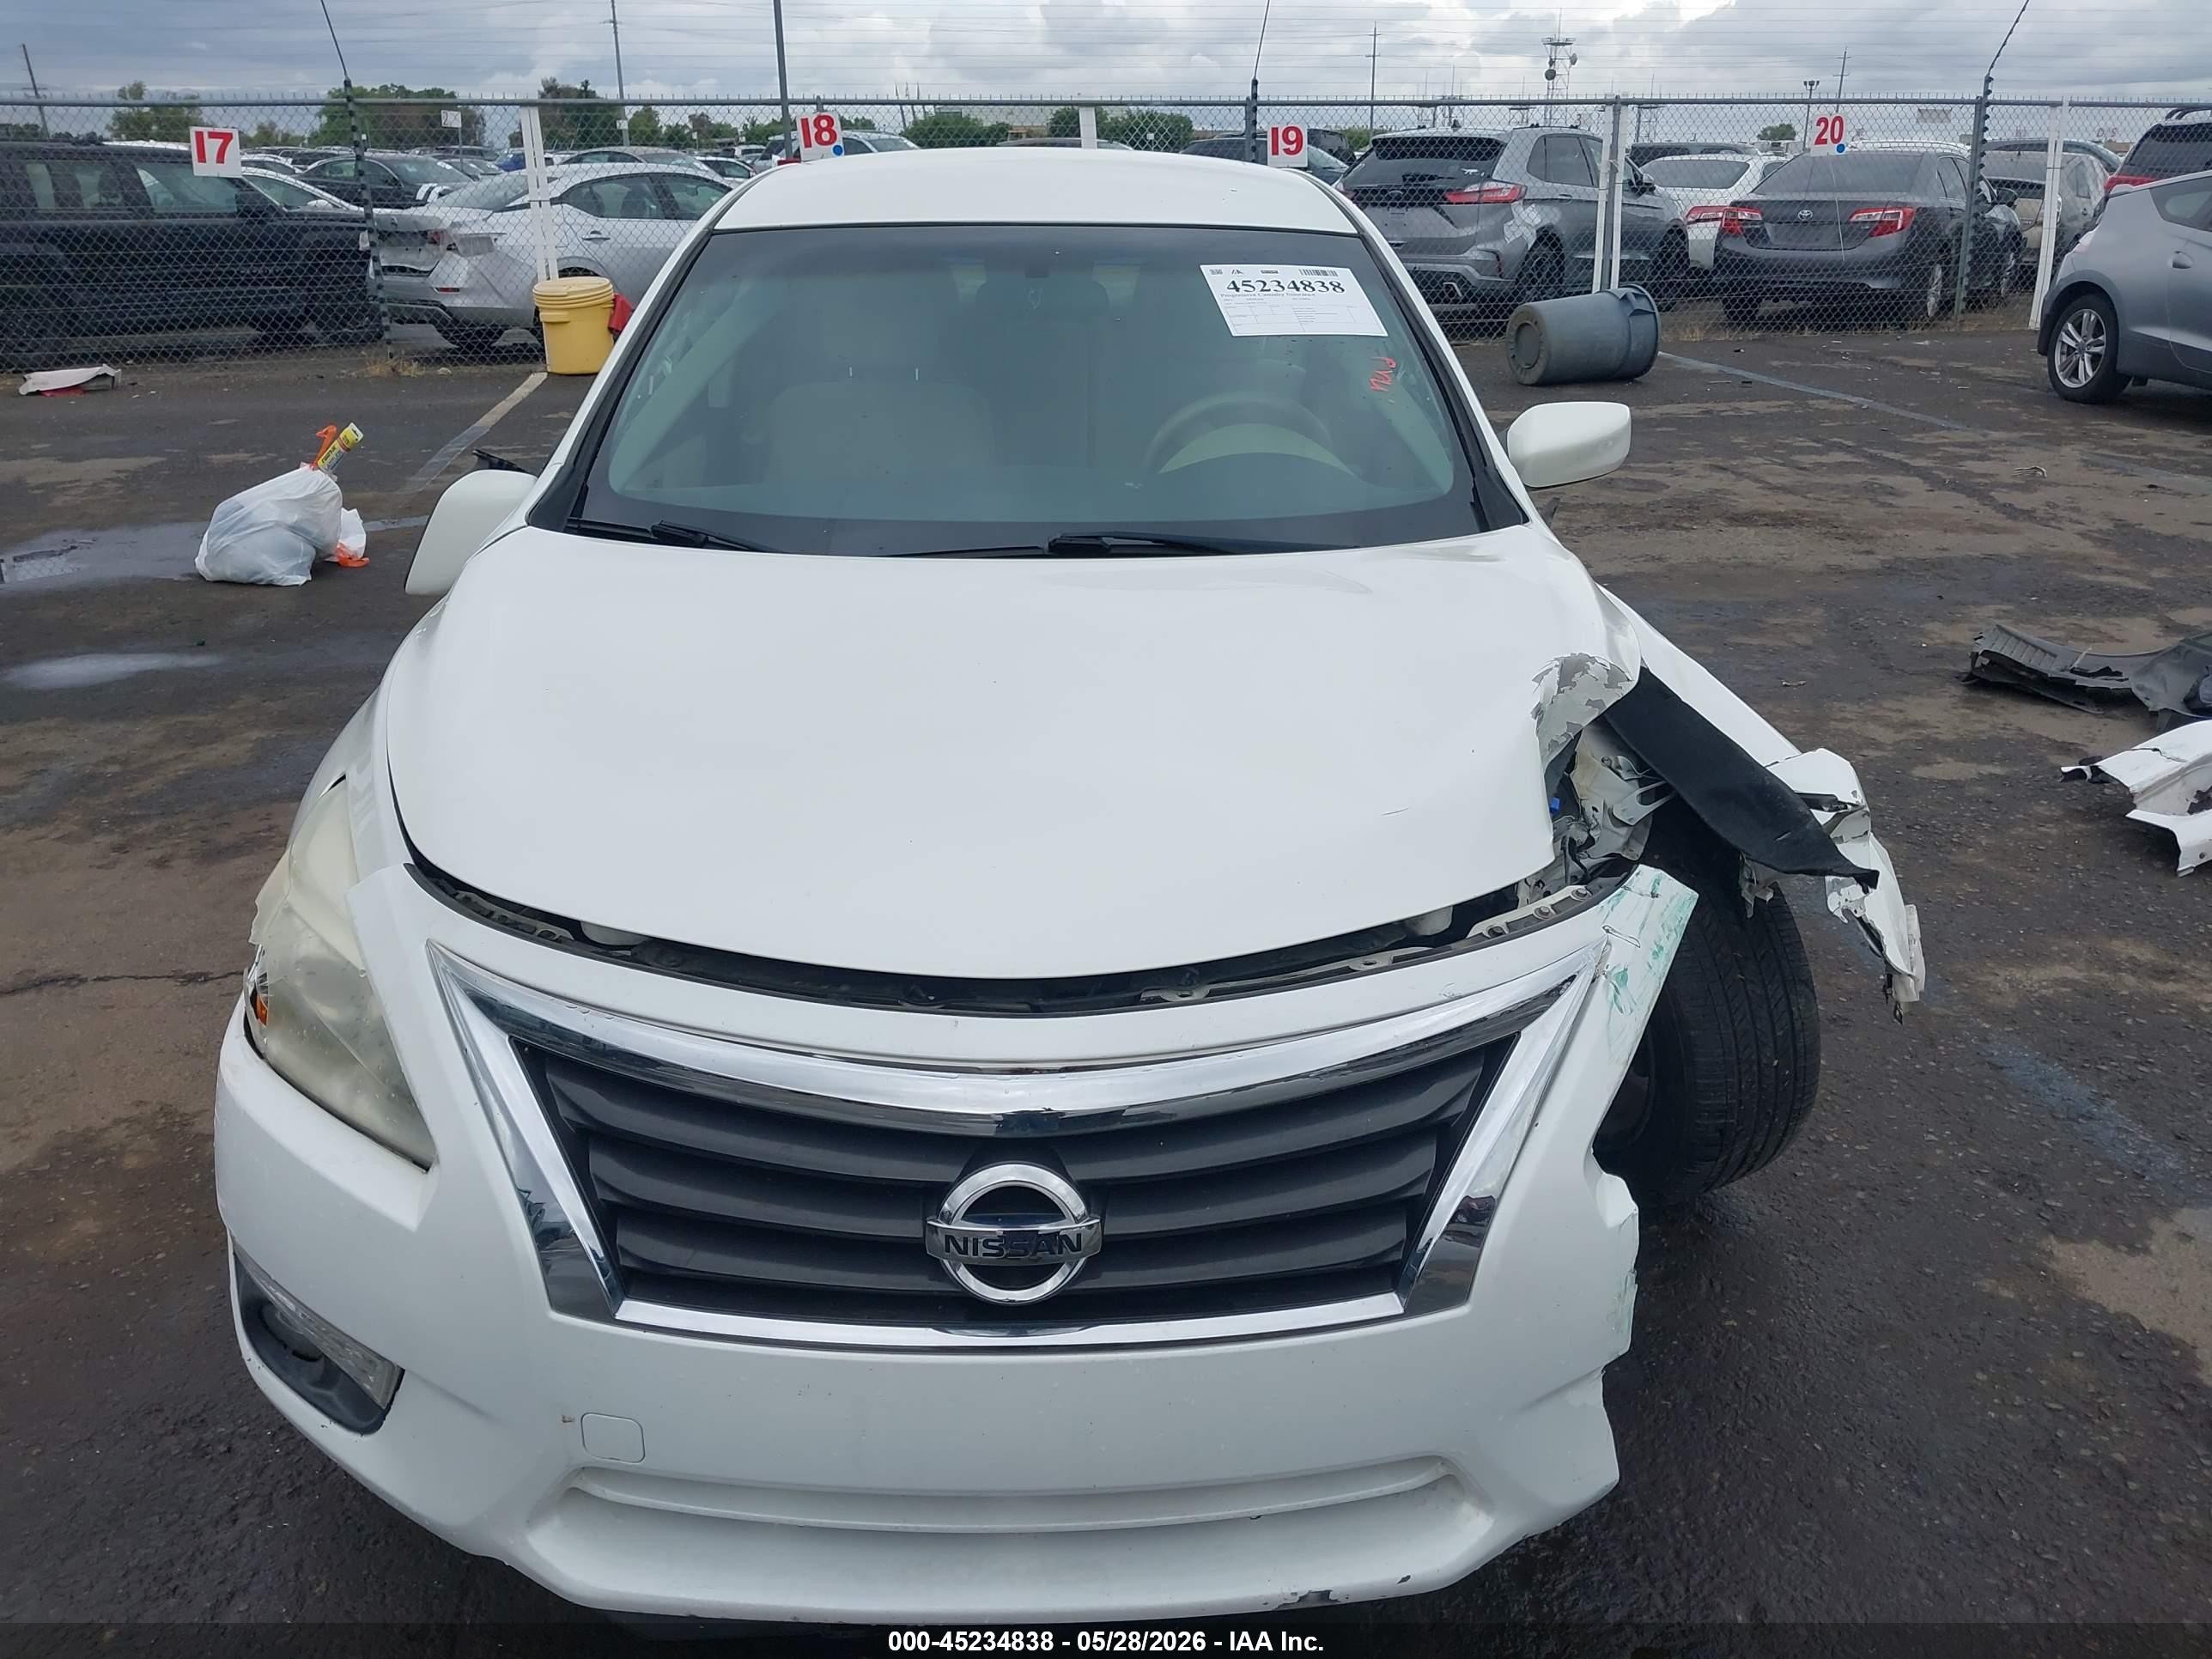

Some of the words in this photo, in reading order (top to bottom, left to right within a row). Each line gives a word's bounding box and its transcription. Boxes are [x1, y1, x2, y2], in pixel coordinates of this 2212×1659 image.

[800, 114, 838, 148] 18
[1271, 126, 1304, 155] 19
[1814, 116, 1844, 145] 20
[195, 131, 234, 163] 17
[1227, 279, 1346, 294] 45234838
[944, 1234, 1082, 1258] NISSAN
